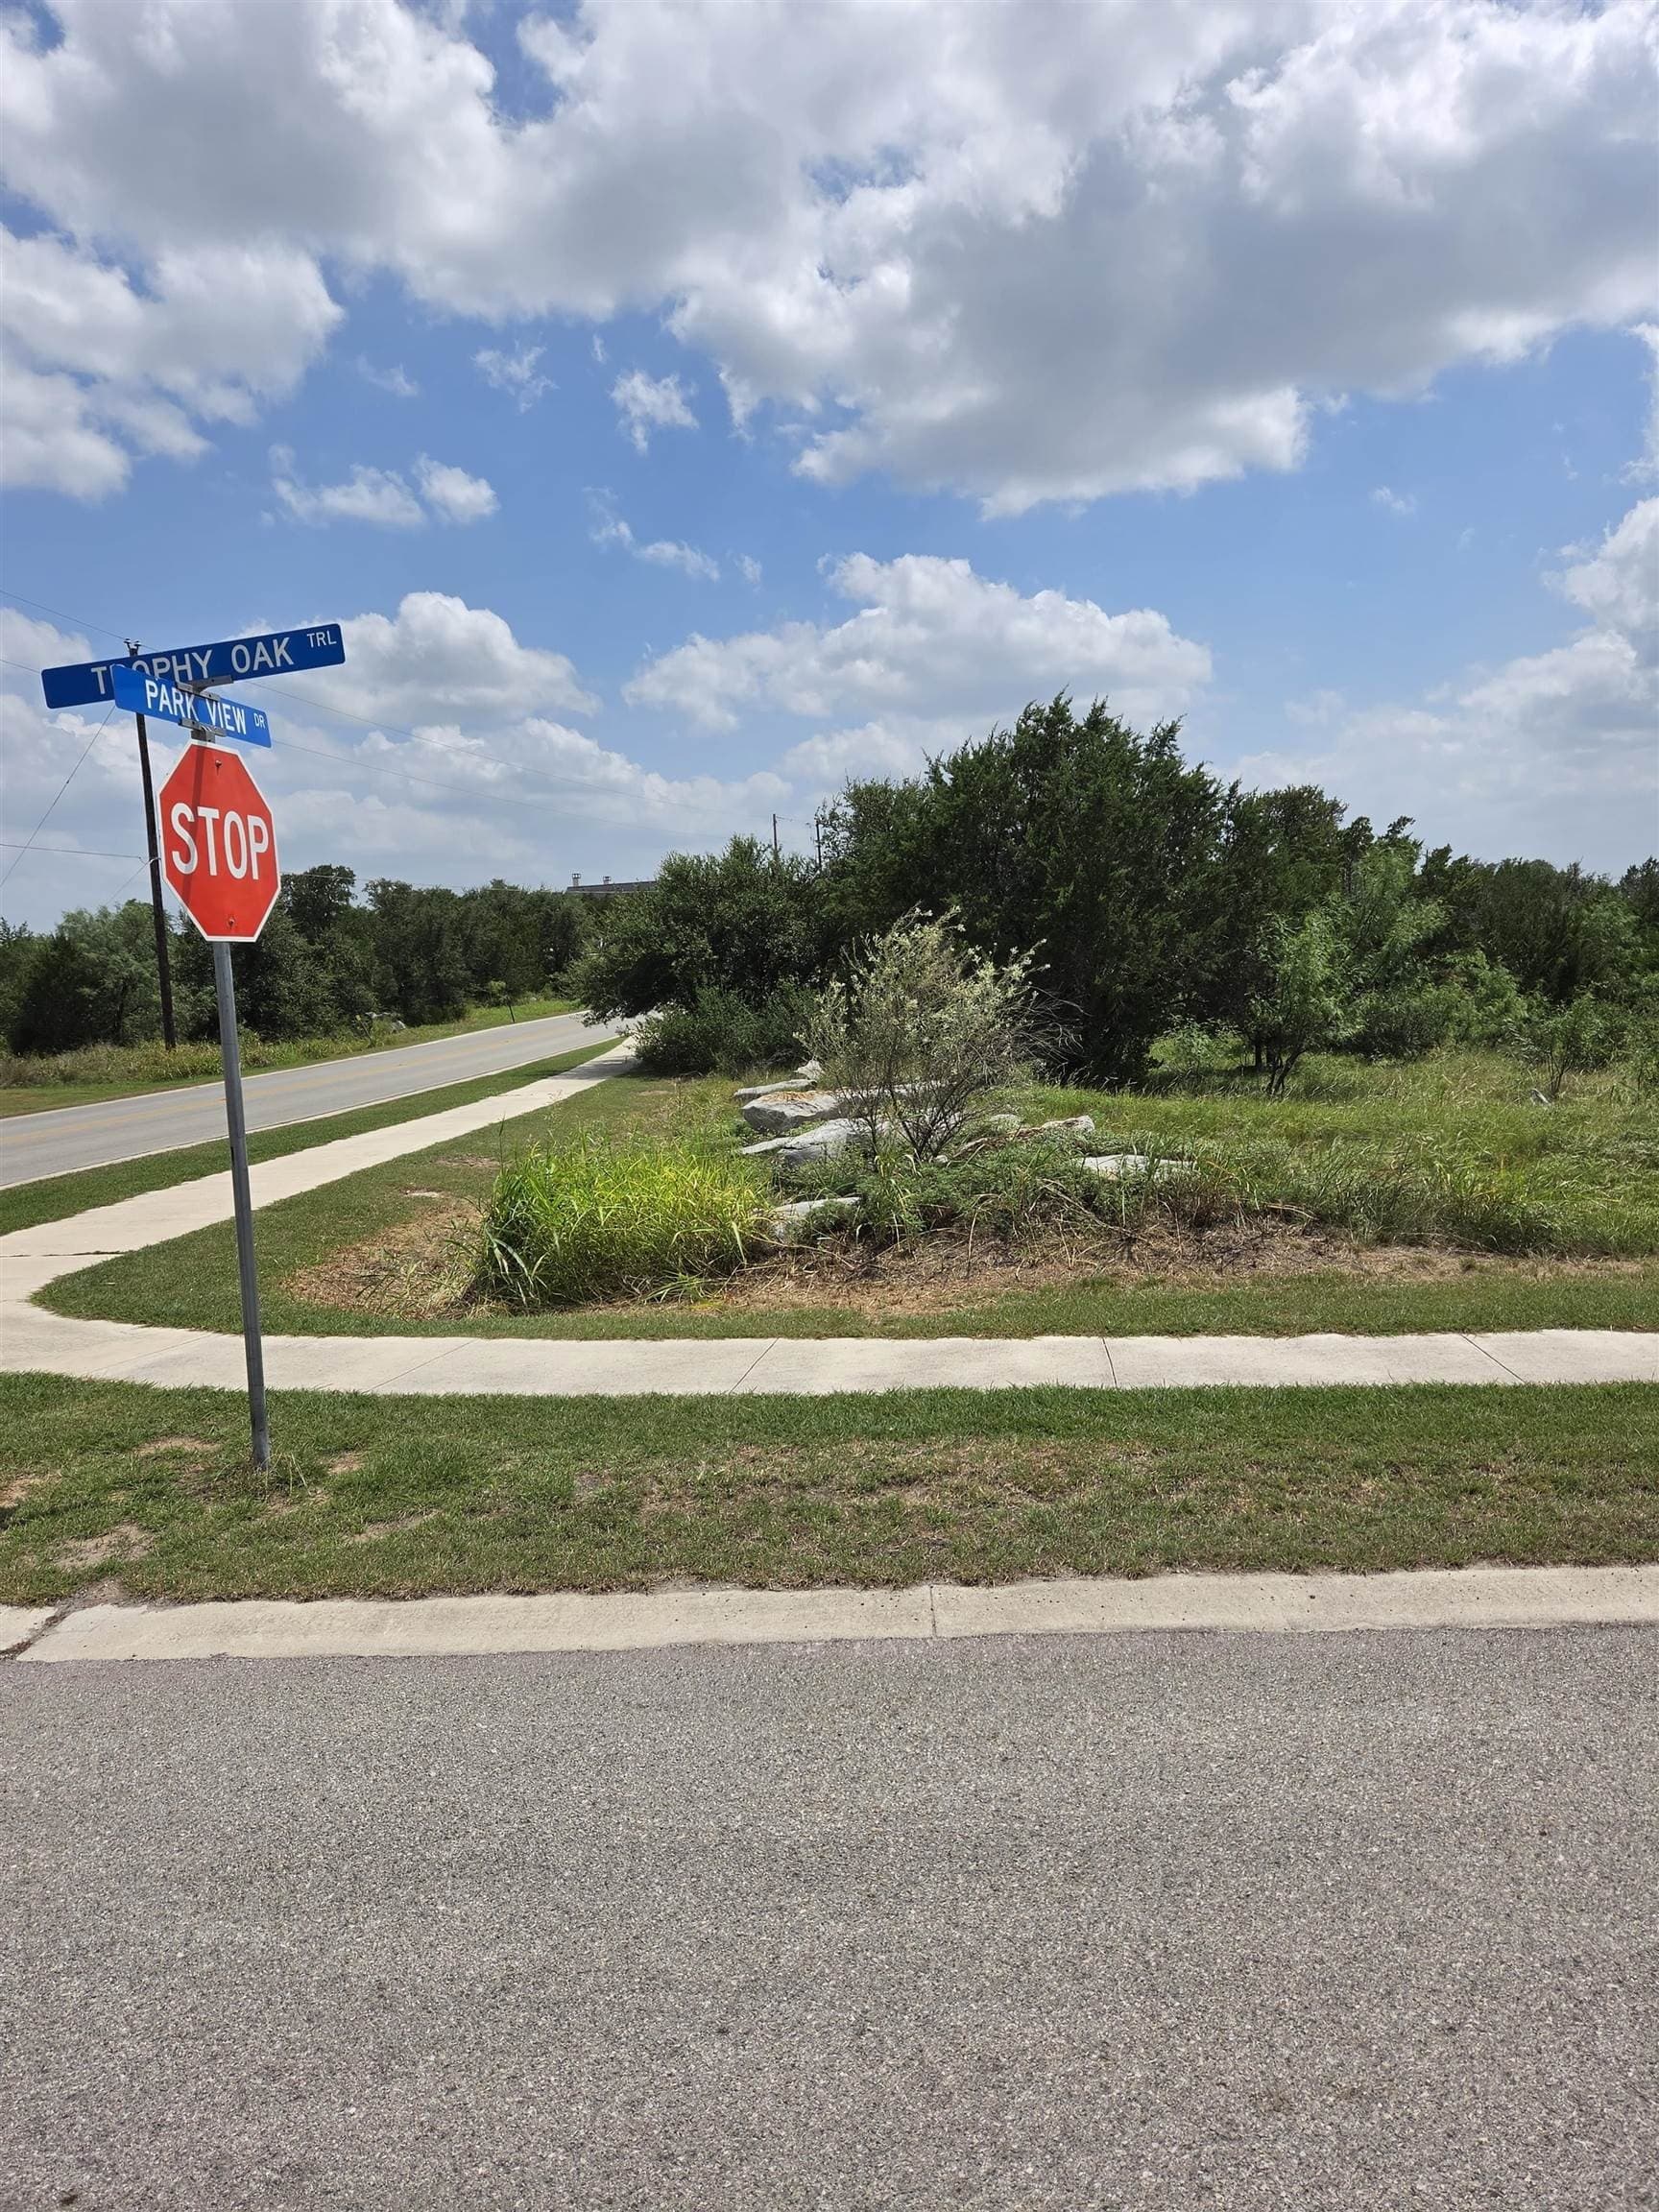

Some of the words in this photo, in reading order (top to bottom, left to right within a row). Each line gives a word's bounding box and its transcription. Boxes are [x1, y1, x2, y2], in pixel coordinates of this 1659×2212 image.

[90, 650, 213, 695] TPHY
[231, 637, 294, 674] OAK
[306, 631, 337, 648] TRL
[145, 679, 200, 722] PARK
[205, 699, 247, 734] VIEW
[253, 712, 266, 730] DR
[171, 803, 269, 880] STOP
